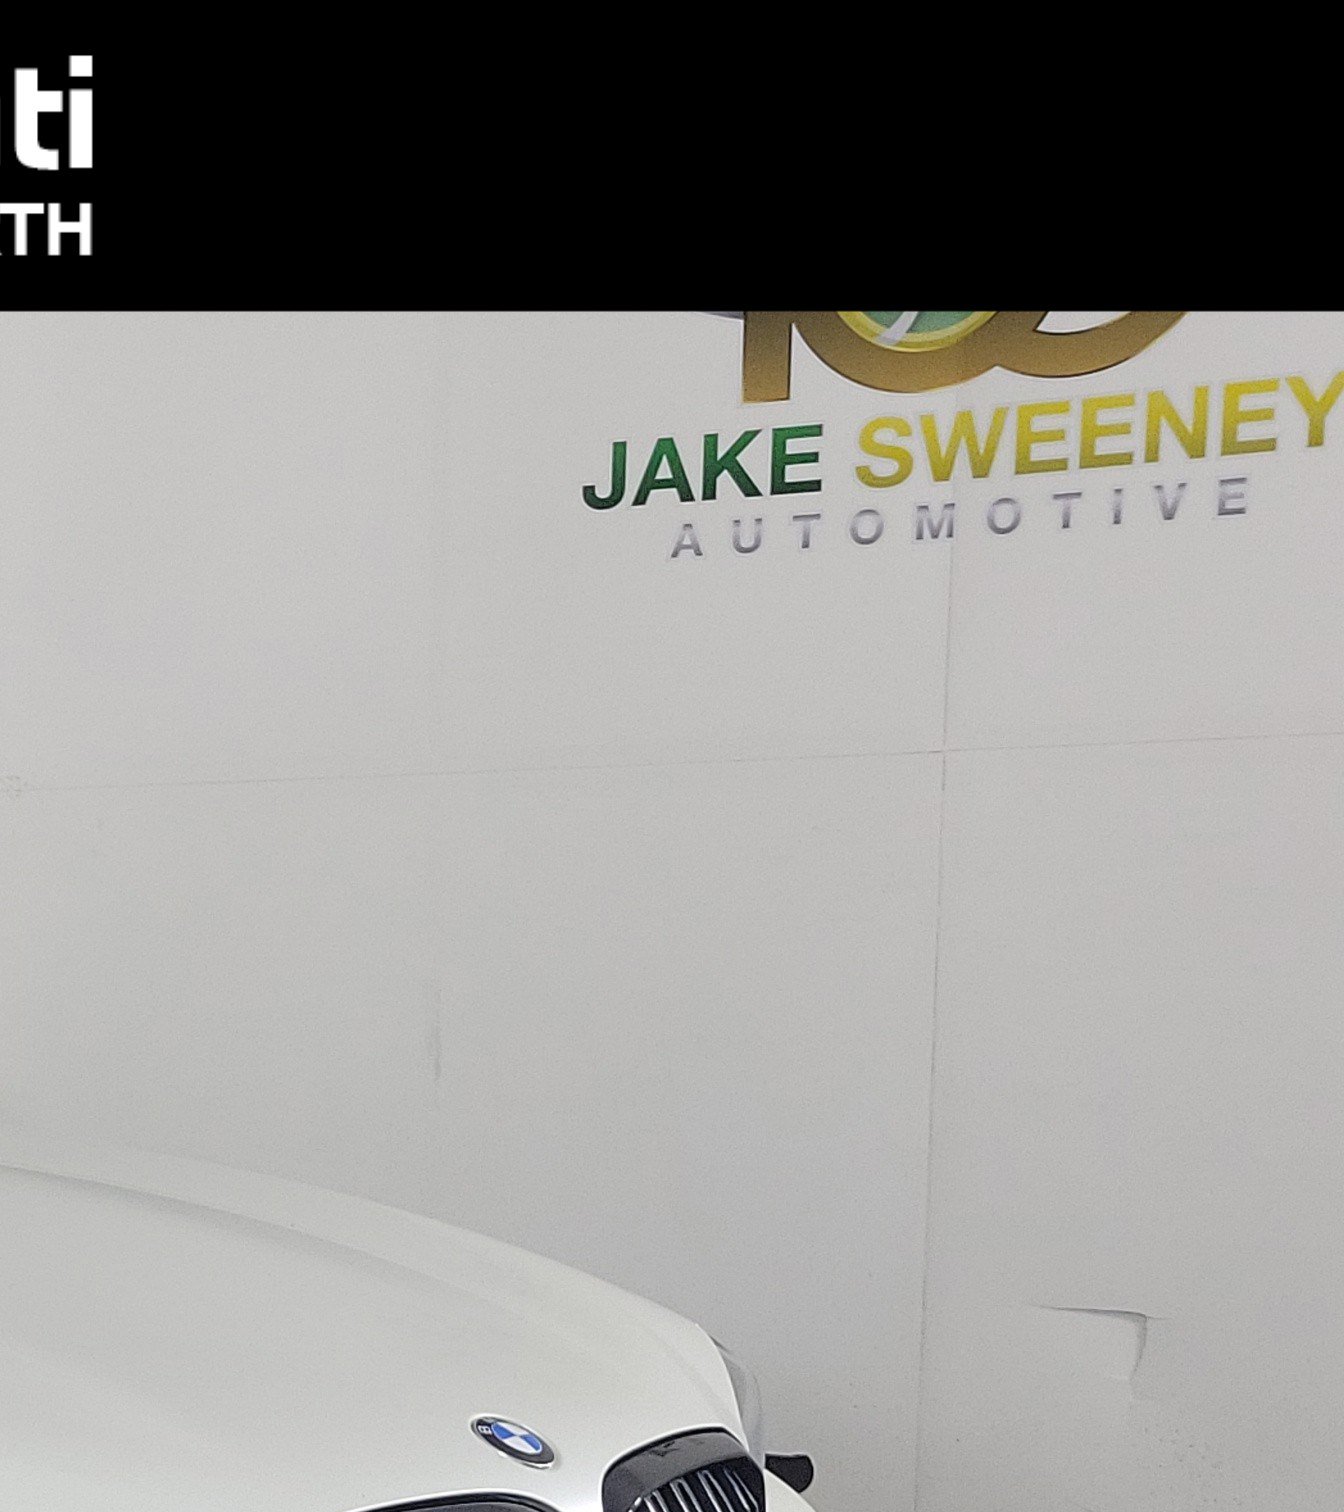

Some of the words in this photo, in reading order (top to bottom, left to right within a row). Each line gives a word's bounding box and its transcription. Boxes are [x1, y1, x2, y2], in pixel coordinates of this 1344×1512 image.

[582, 422, 825, 511] JAKE
[854, 368, 1344, 490] SWEENEY
[669, 476, 1248, 559] AUTOMOTIVE
